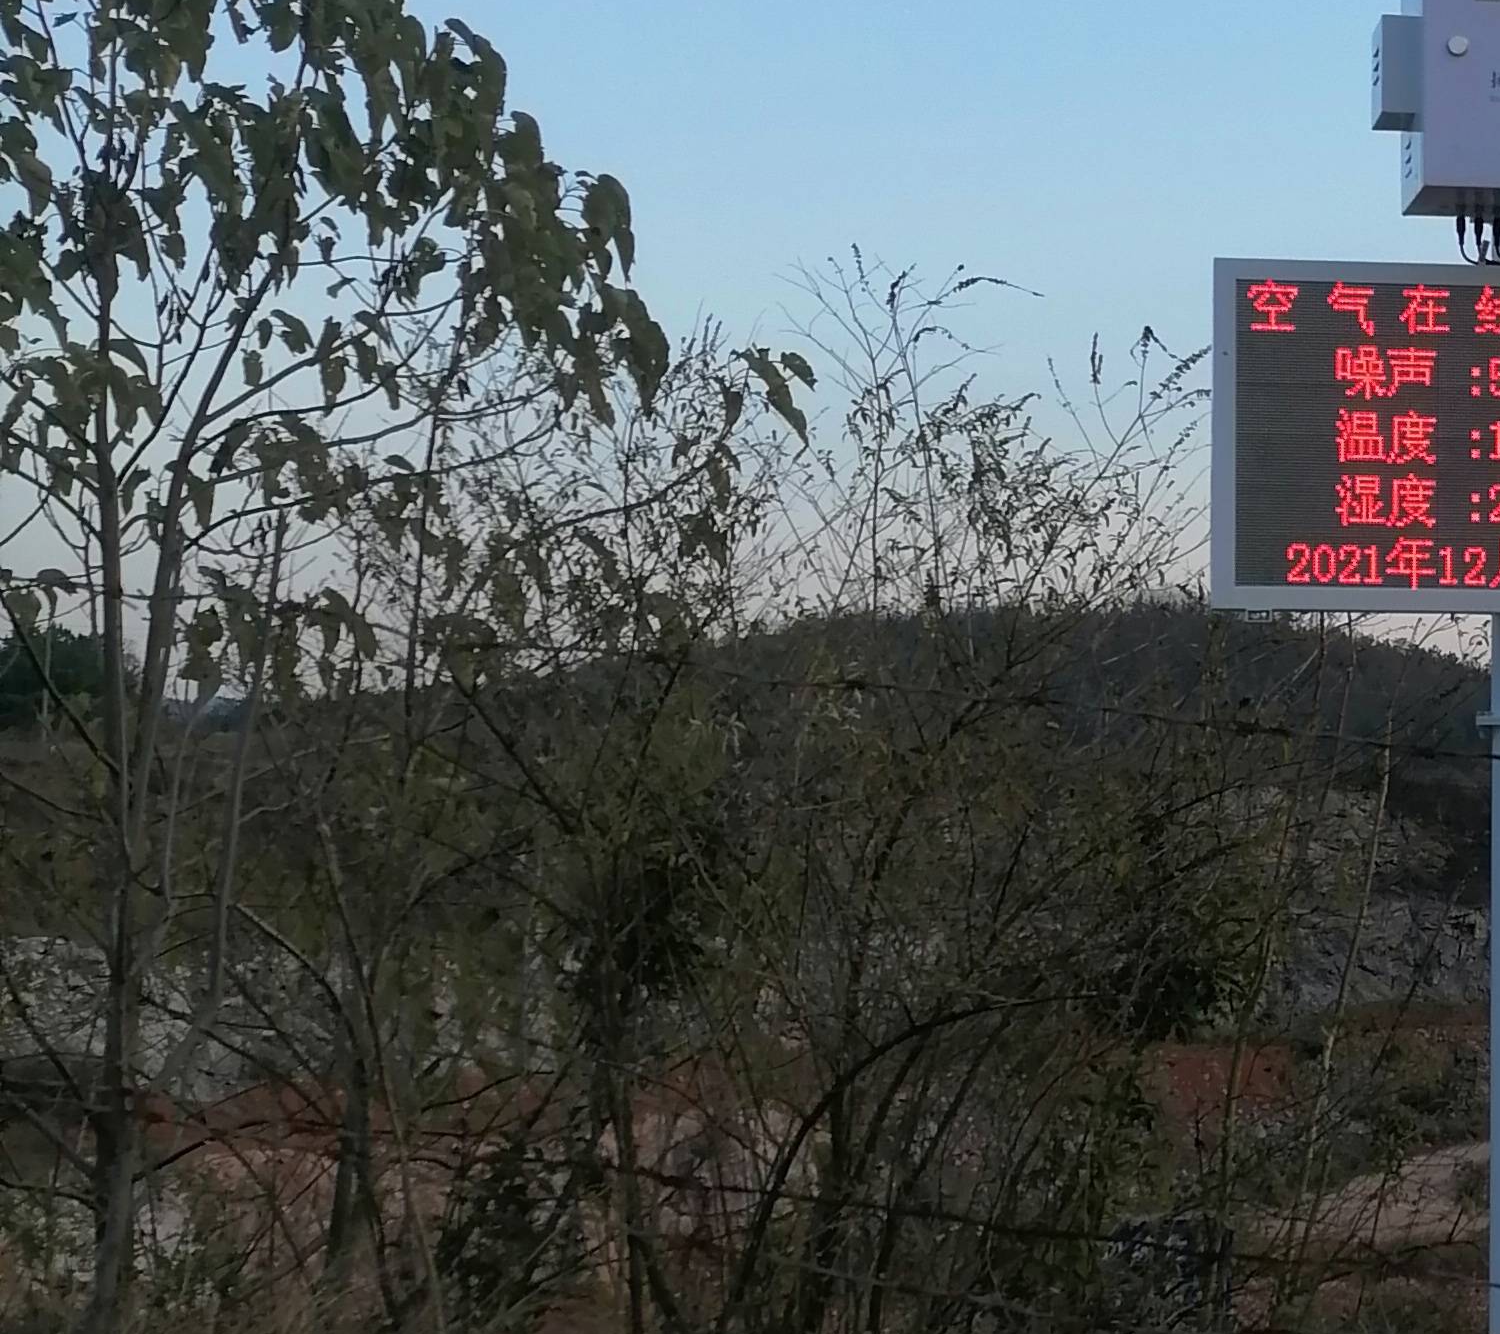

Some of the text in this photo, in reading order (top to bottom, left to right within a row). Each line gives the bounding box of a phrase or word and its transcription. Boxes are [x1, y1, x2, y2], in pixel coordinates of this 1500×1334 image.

[1334, 344, 1437, 400] 噪声
[1334, 407, 1437, 465] 温度
[1334, 472, 1437, 529] 湿度
